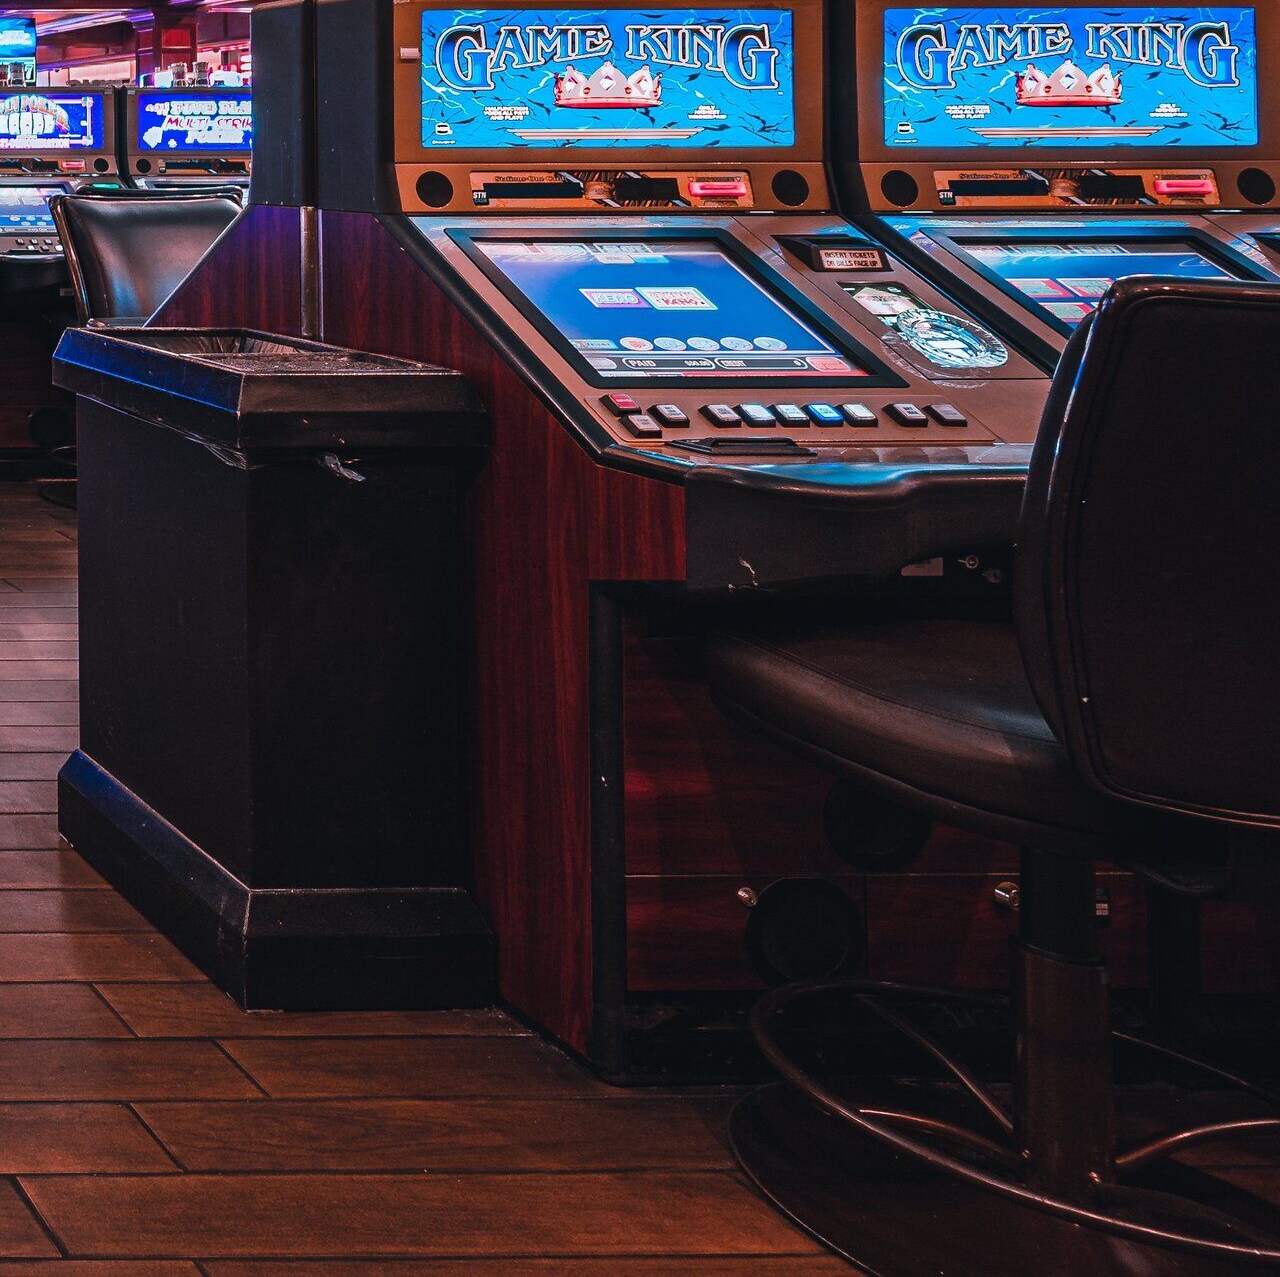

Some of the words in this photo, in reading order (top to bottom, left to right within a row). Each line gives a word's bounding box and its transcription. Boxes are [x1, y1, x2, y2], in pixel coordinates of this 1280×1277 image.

[436, 24, 613, 91] GAME
[625, 24, 780, 90] KING
[897, 23, 1074, 90] GAME
[1085, 21, 1240, 88] KING
